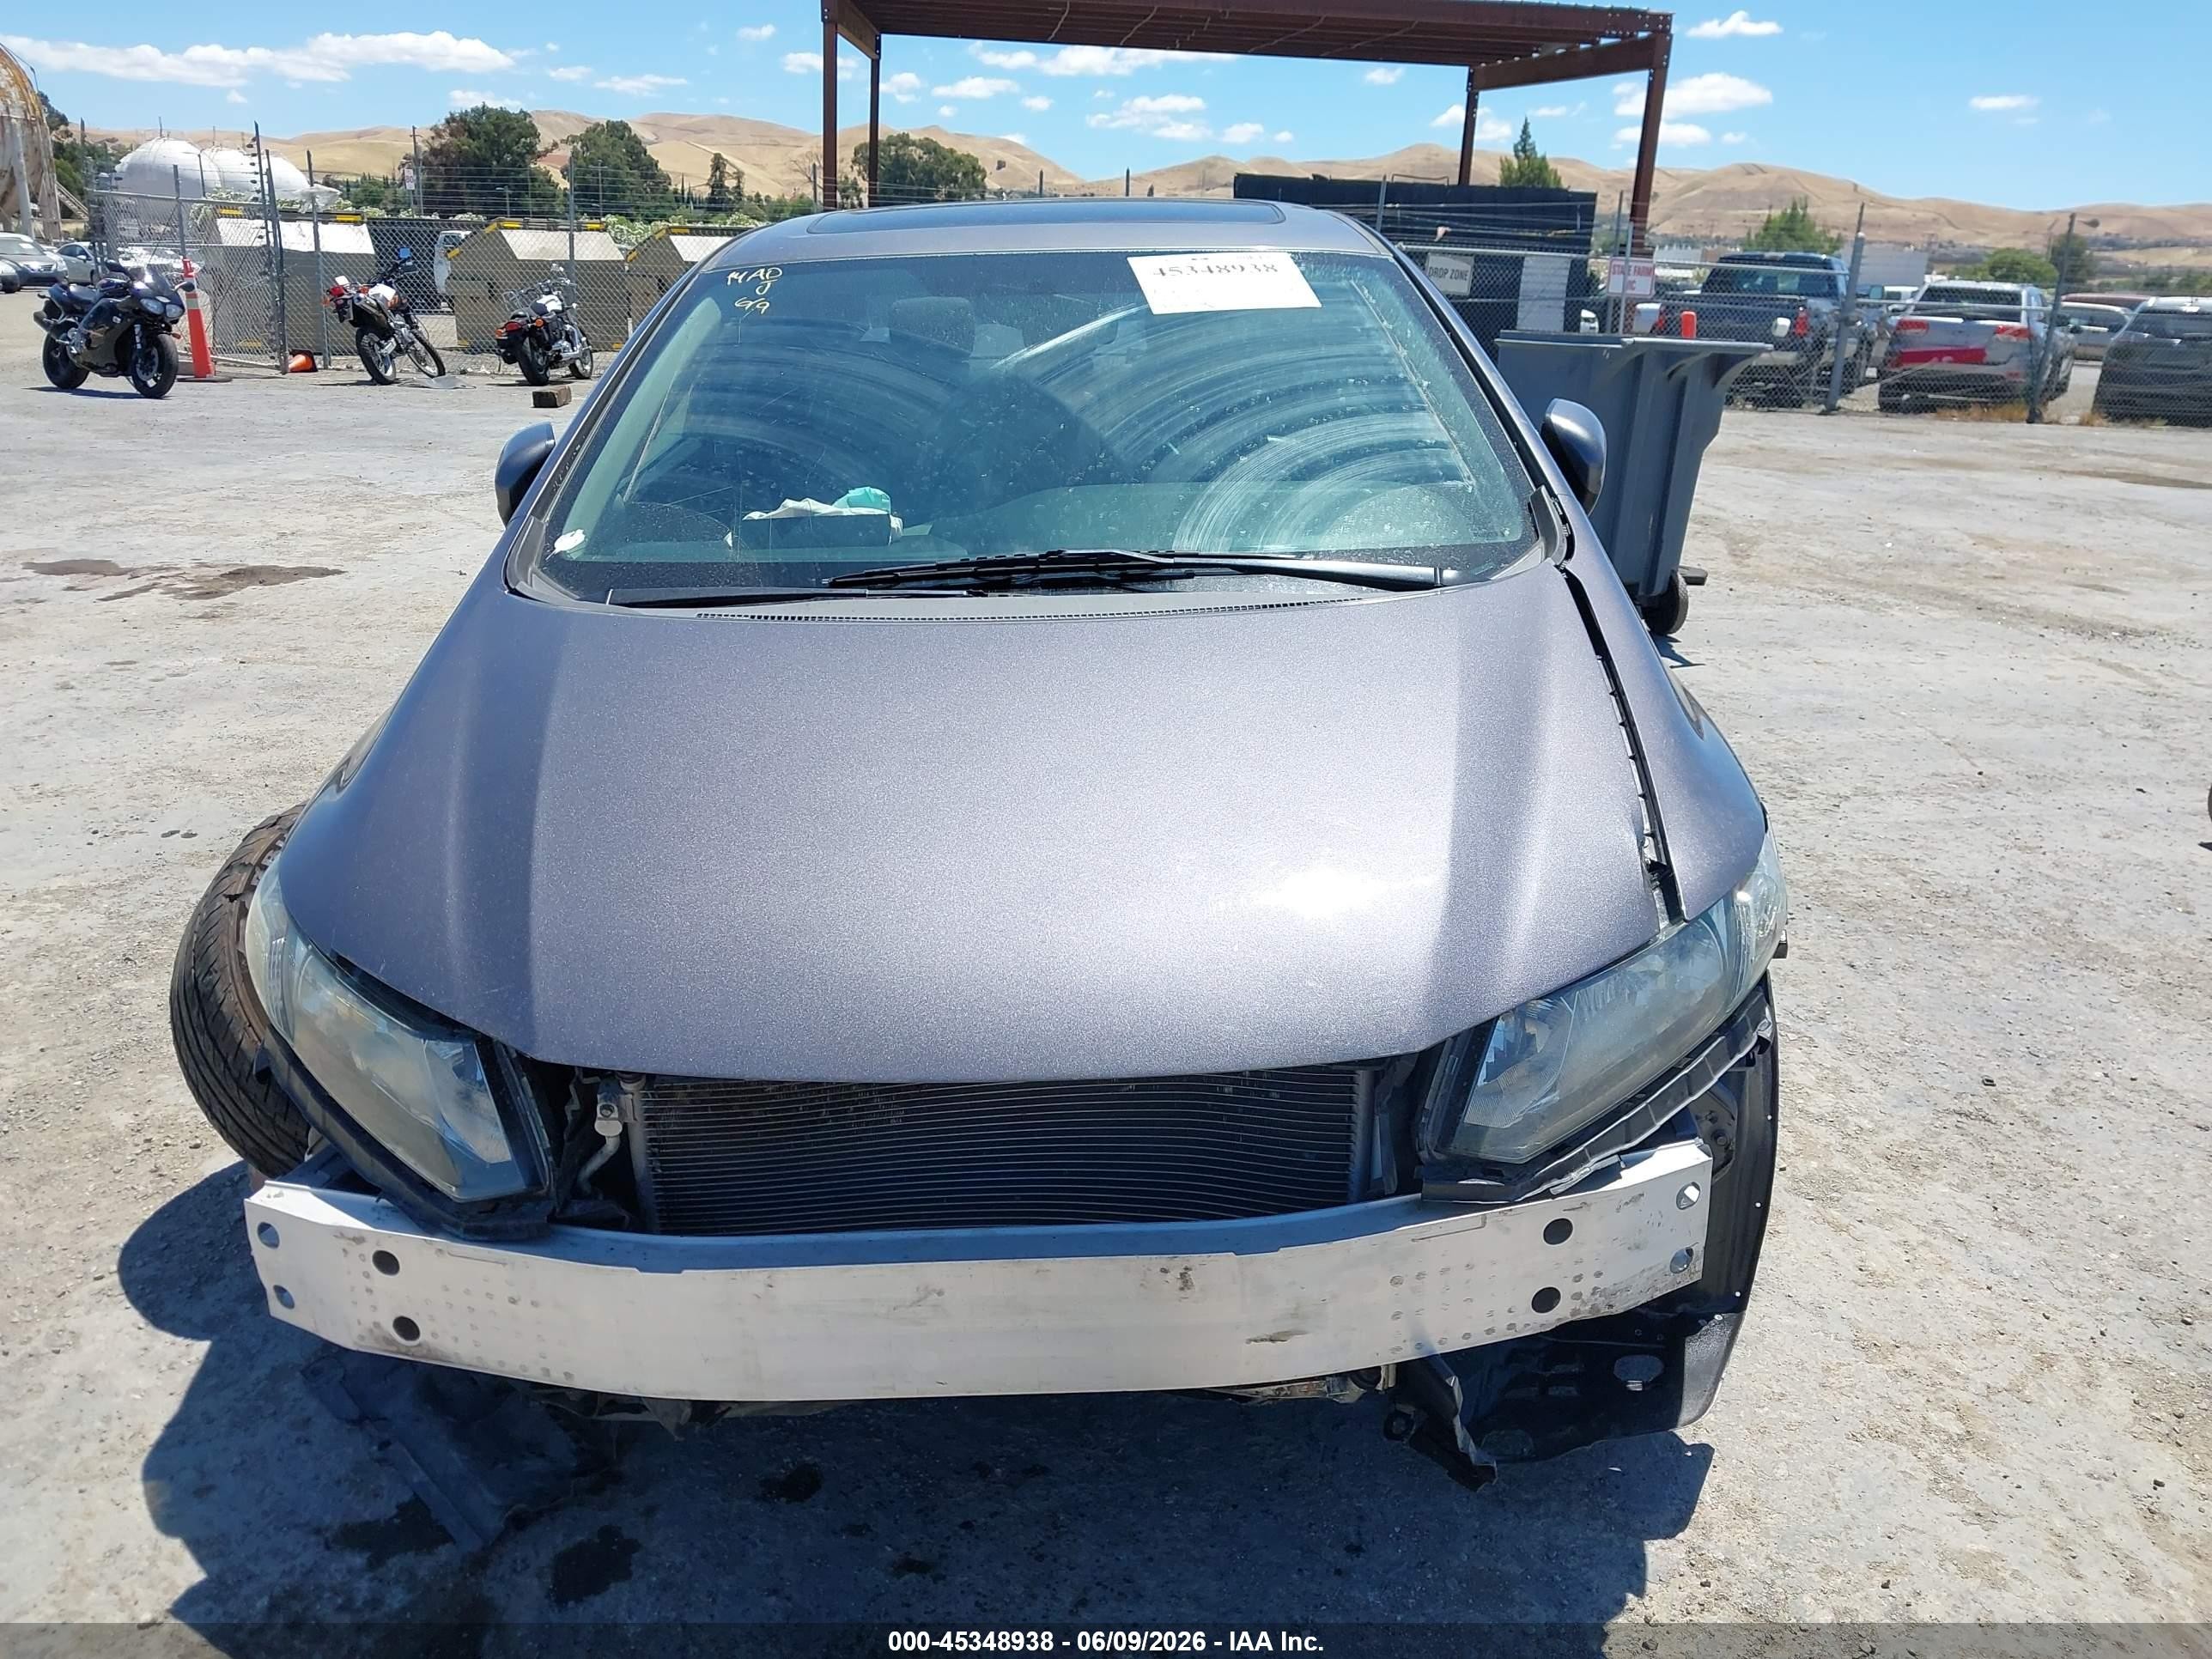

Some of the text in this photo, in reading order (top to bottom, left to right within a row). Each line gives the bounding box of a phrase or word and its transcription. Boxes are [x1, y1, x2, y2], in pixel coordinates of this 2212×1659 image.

[1428, 266, 1469, 282] DROP ZONE
[1612, 264, 1632, 276] STAE
